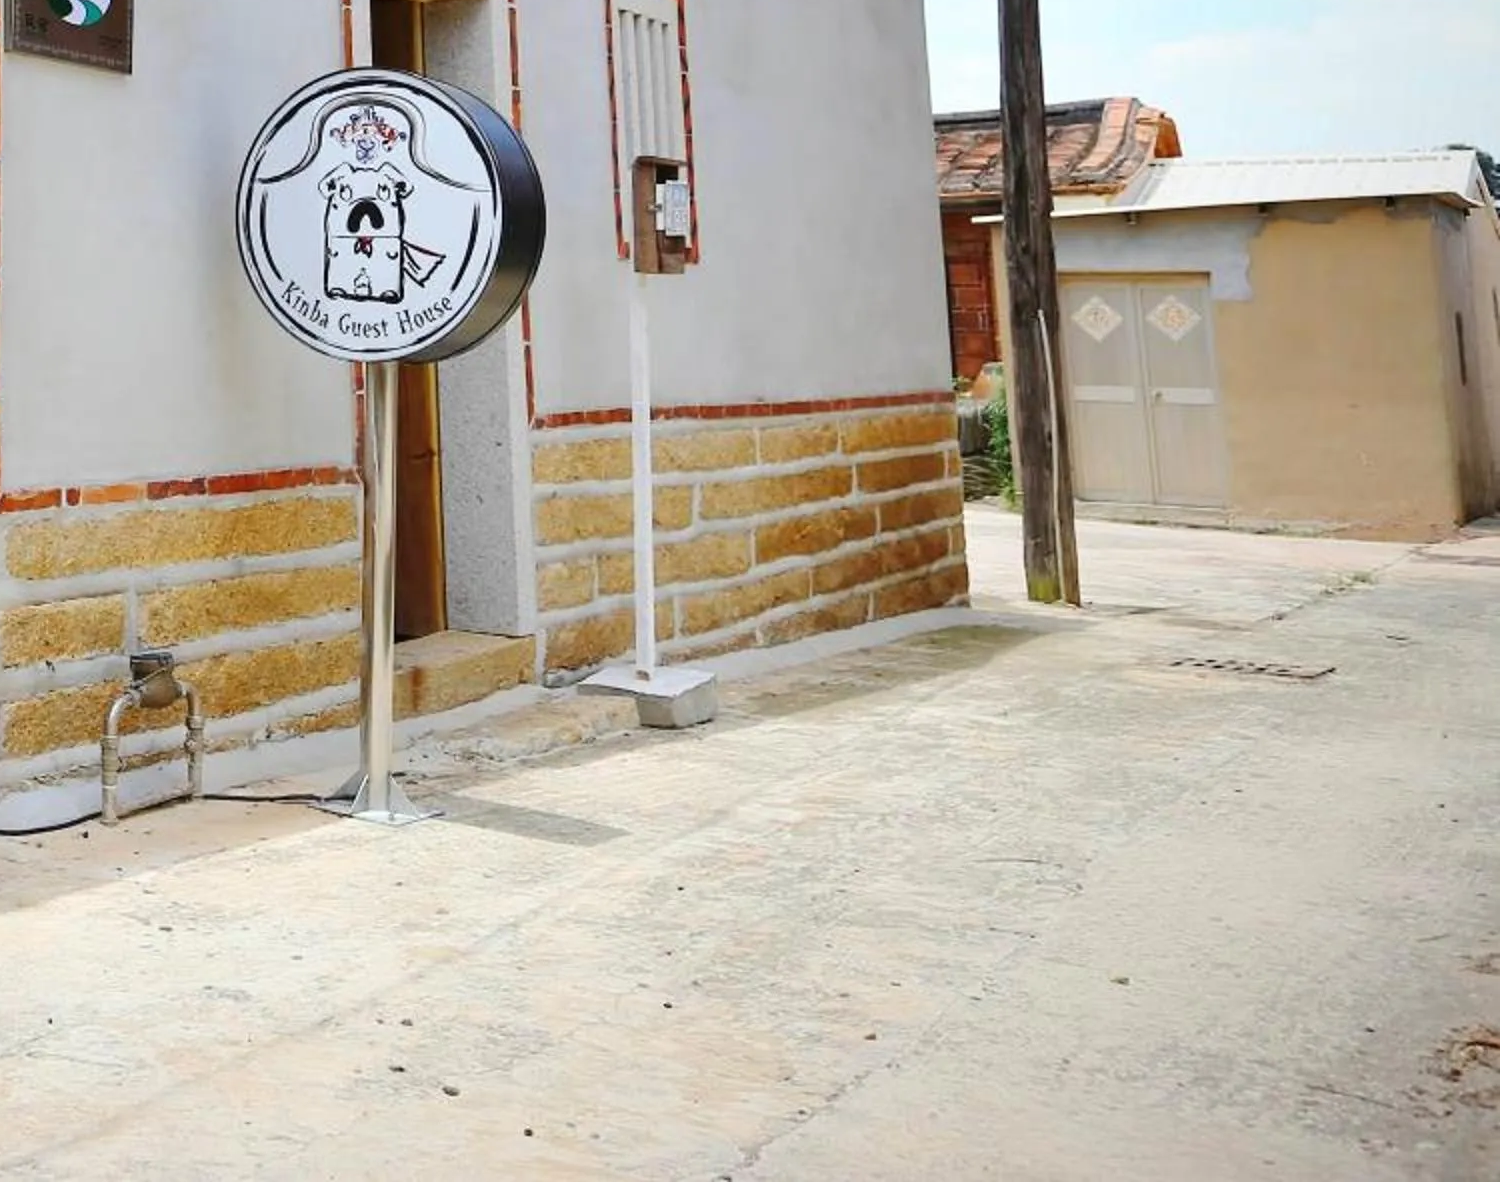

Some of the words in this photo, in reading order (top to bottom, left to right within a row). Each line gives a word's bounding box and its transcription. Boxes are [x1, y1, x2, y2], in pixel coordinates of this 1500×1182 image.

[281, 281, 330, 328] Kinba
[338, 314, 388, 338] Guest
[397, 296, 453, 334] House
